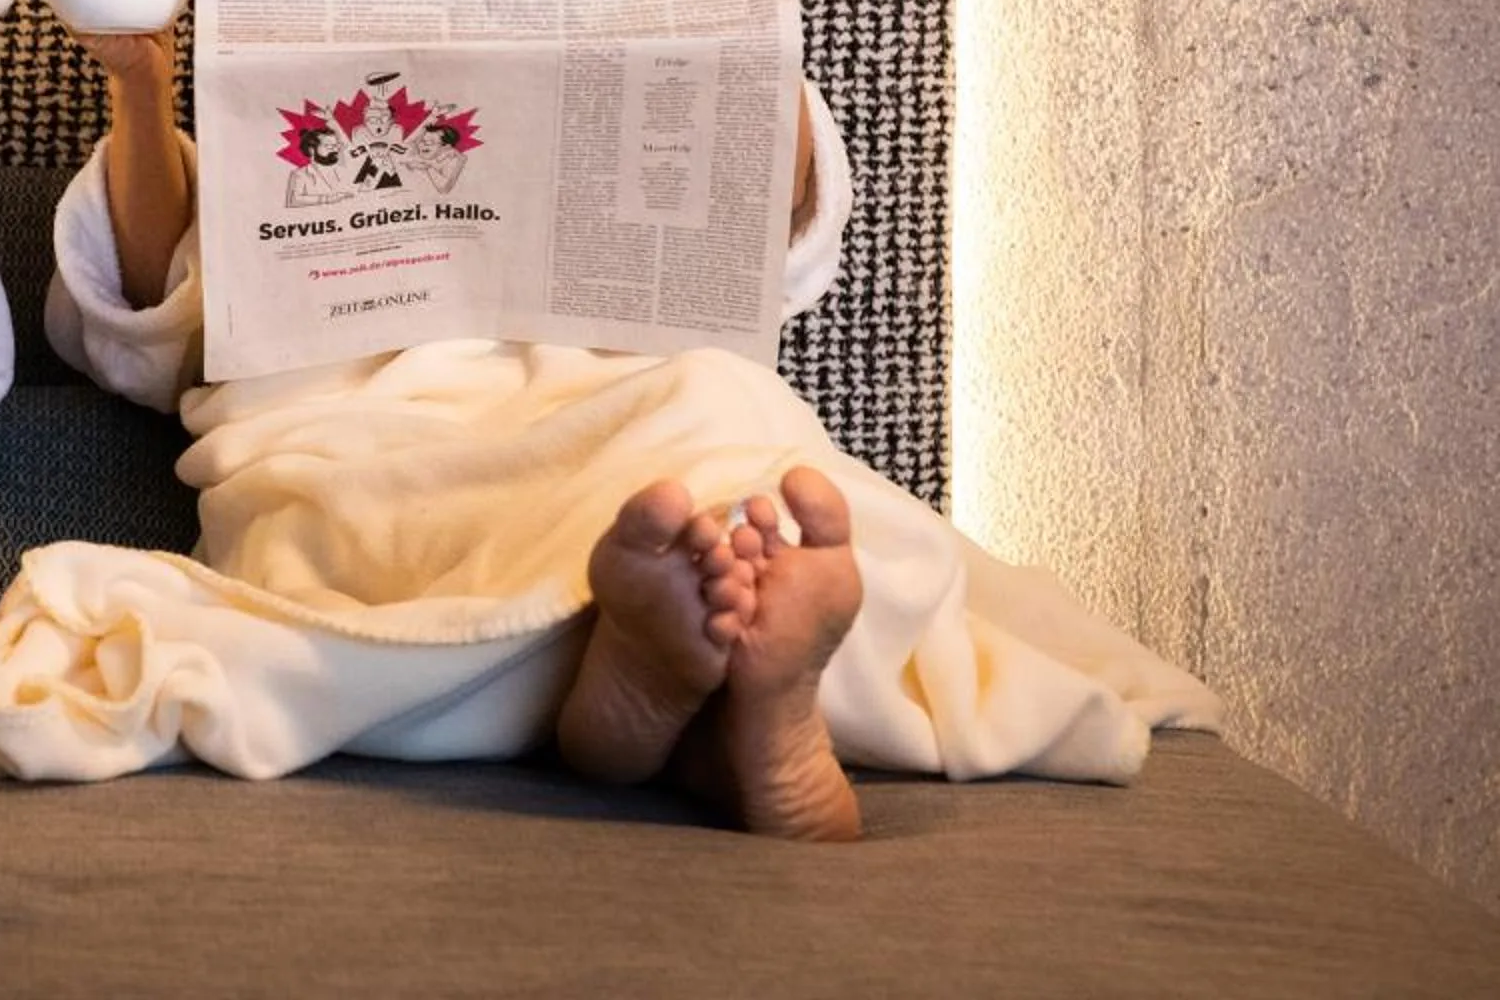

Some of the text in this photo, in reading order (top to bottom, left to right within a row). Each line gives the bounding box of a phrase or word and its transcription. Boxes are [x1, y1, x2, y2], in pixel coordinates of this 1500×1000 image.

[259, 204, 500, 240] Servus. Grüezi. Hallo.
